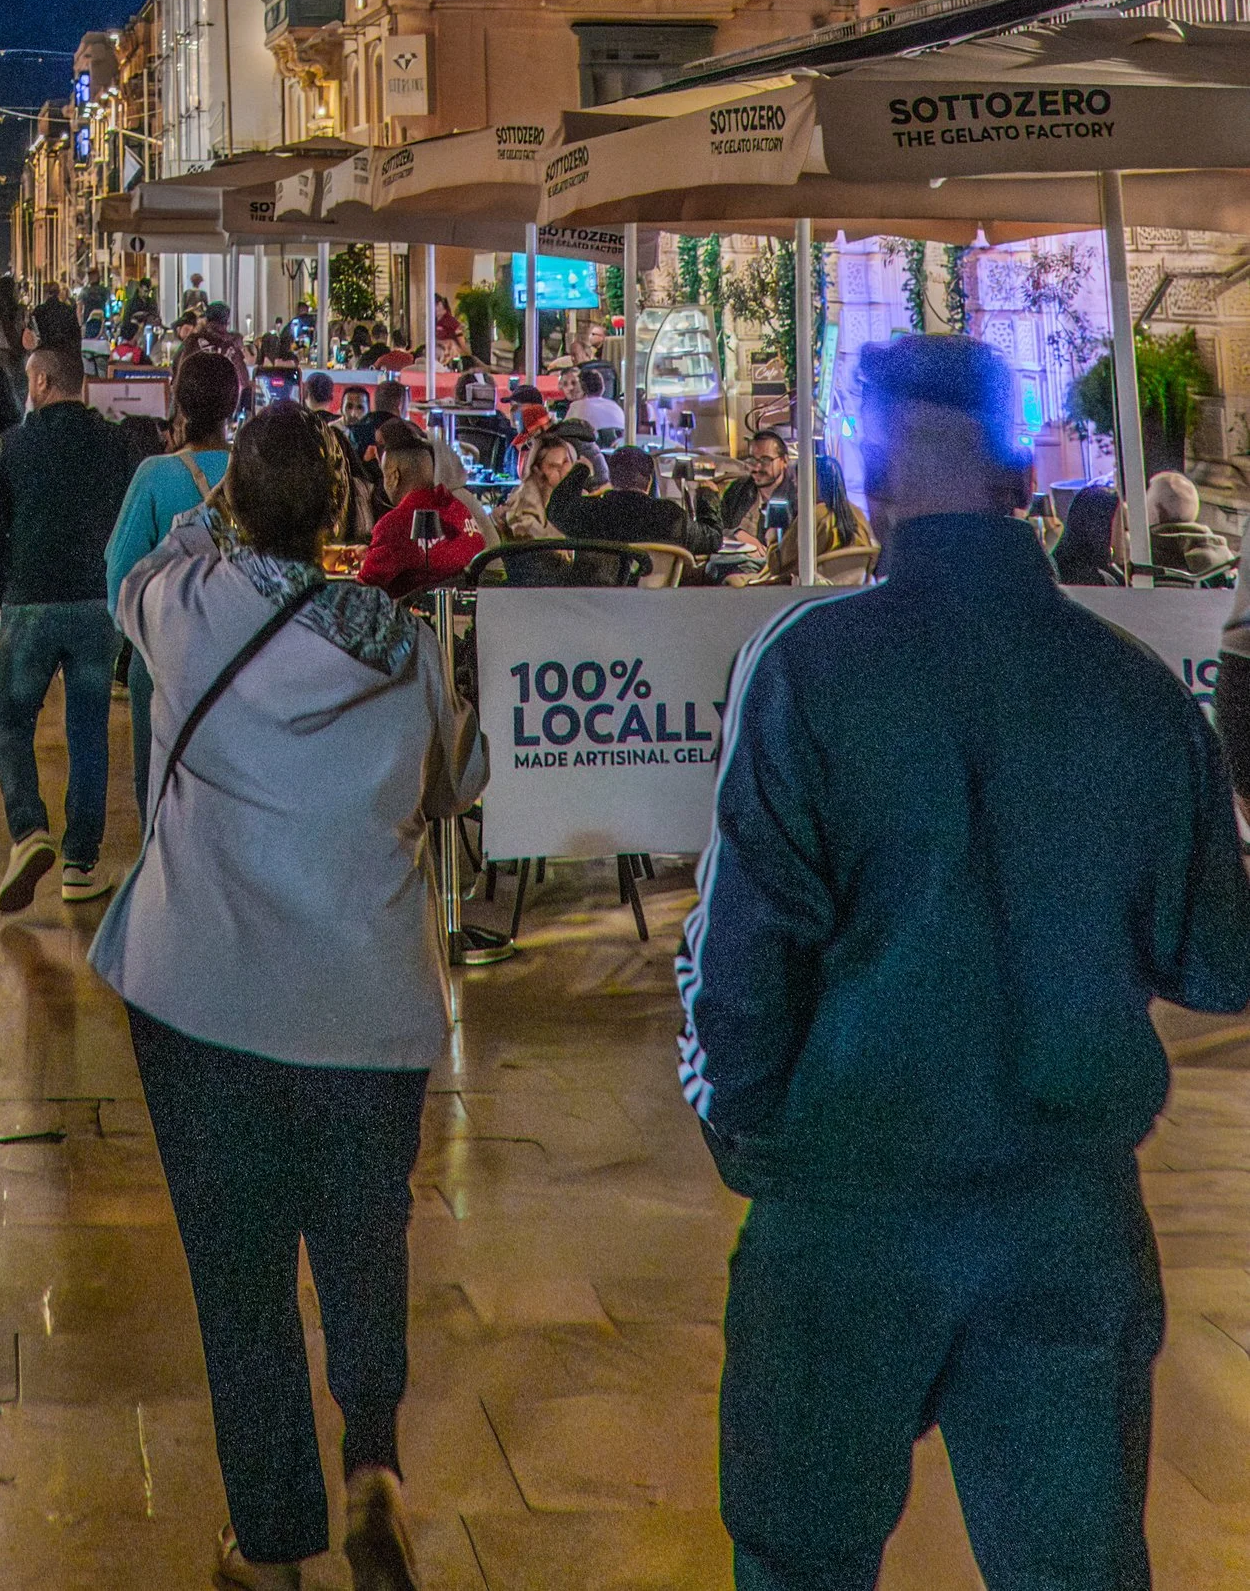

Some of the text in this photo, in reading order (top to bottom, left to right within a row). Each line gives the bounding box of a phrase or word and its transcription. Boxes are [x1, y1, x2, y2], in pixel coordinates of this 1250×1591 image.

[710, 105, 786, 134] SOTTOZERO
[889, 89, 1111, 125] SOTTOZERO
[496, 126, 545, 145] SOTTOZERO
[711, 136, 784, 154] THE GELATO FACTORY
[893, 122, 1115, 147] THE GELATO FACTORY
[545, 145, 589, 183] SOTTOZERO
[510, 658, 652, 703] 100%
[514, 751, 568, 769] MADE
[573, 749, 670, 768] ARTISINAL
